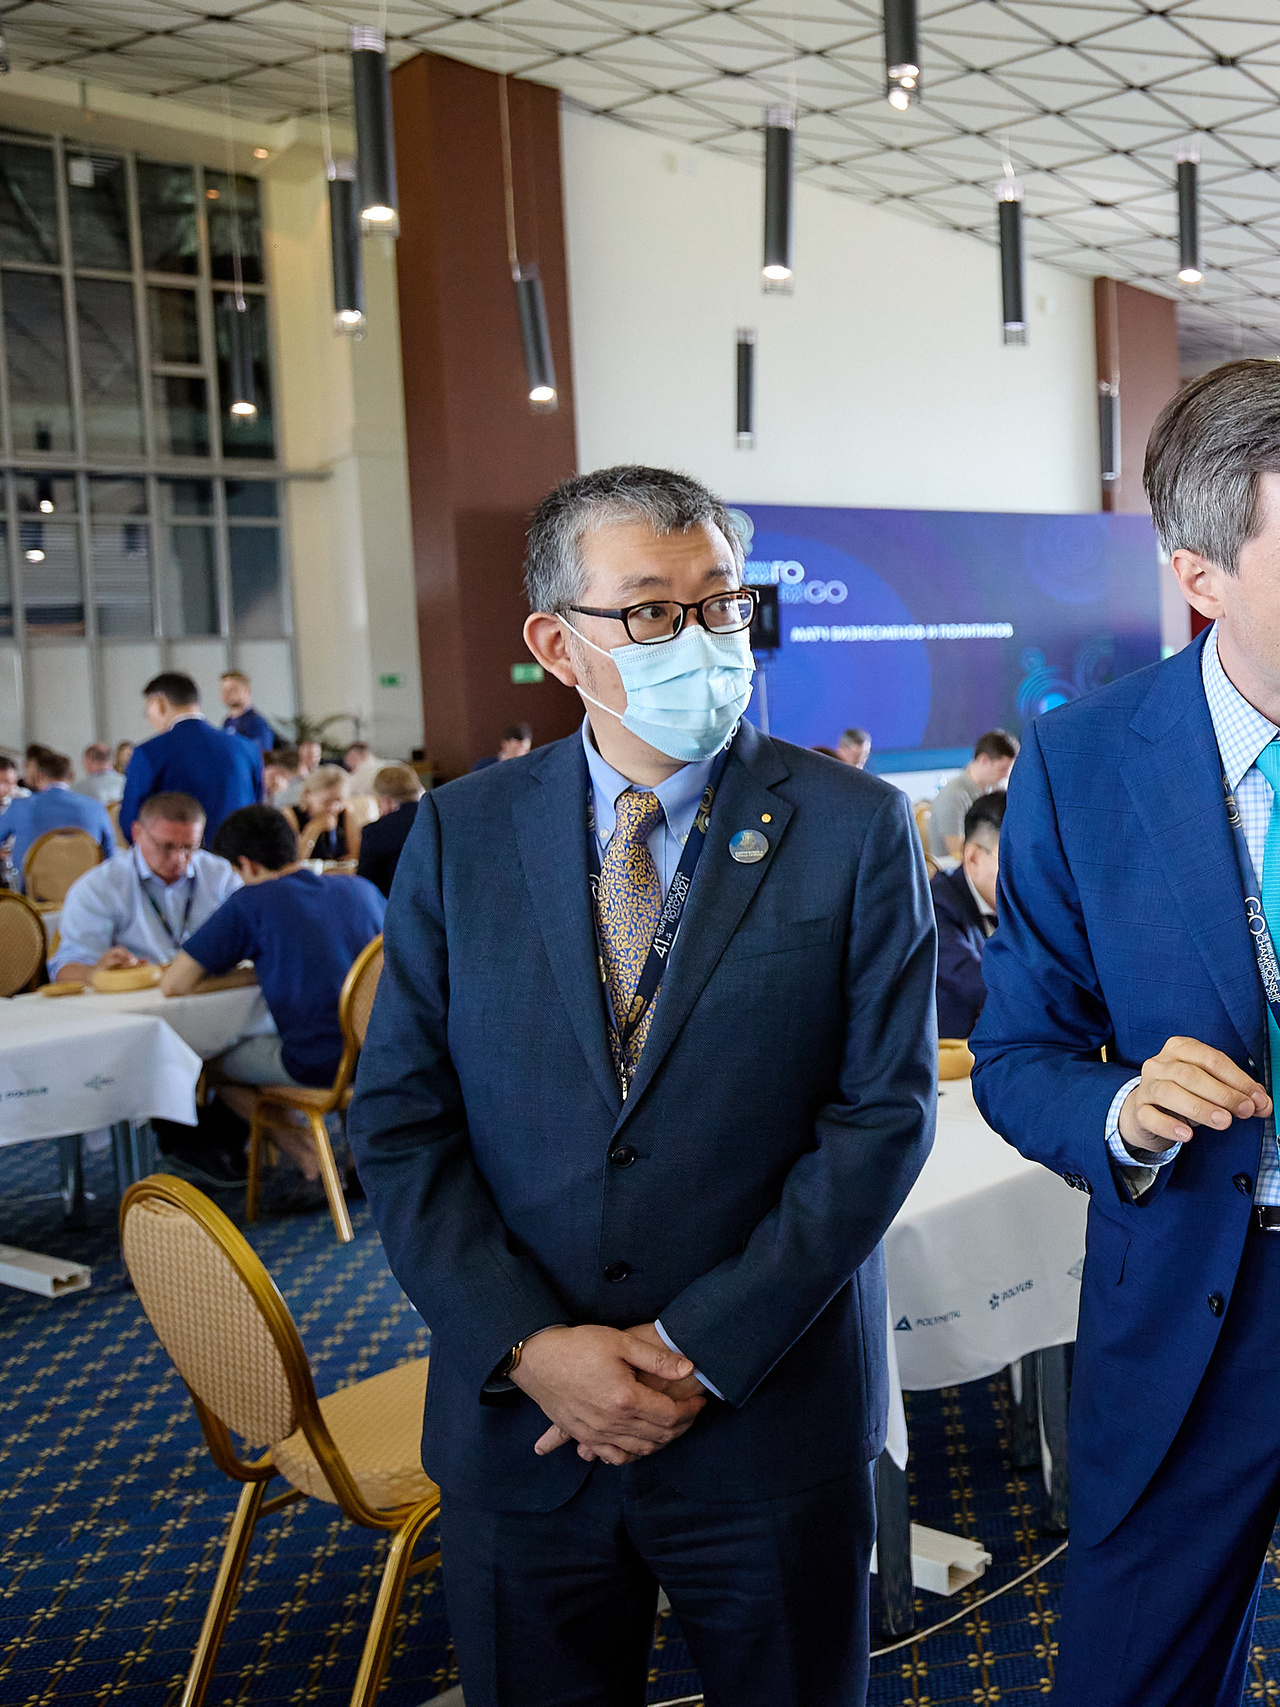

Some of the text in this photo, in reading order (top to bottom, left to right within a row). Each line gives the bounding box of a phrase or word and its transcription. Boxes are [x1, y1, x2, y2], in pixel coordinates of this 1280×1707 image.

[675, 875, 690, 902] 2021
[656, 892, 675, 937] ЧЕМПИОНАТ
[1244, 896, 1266, 935] GO
